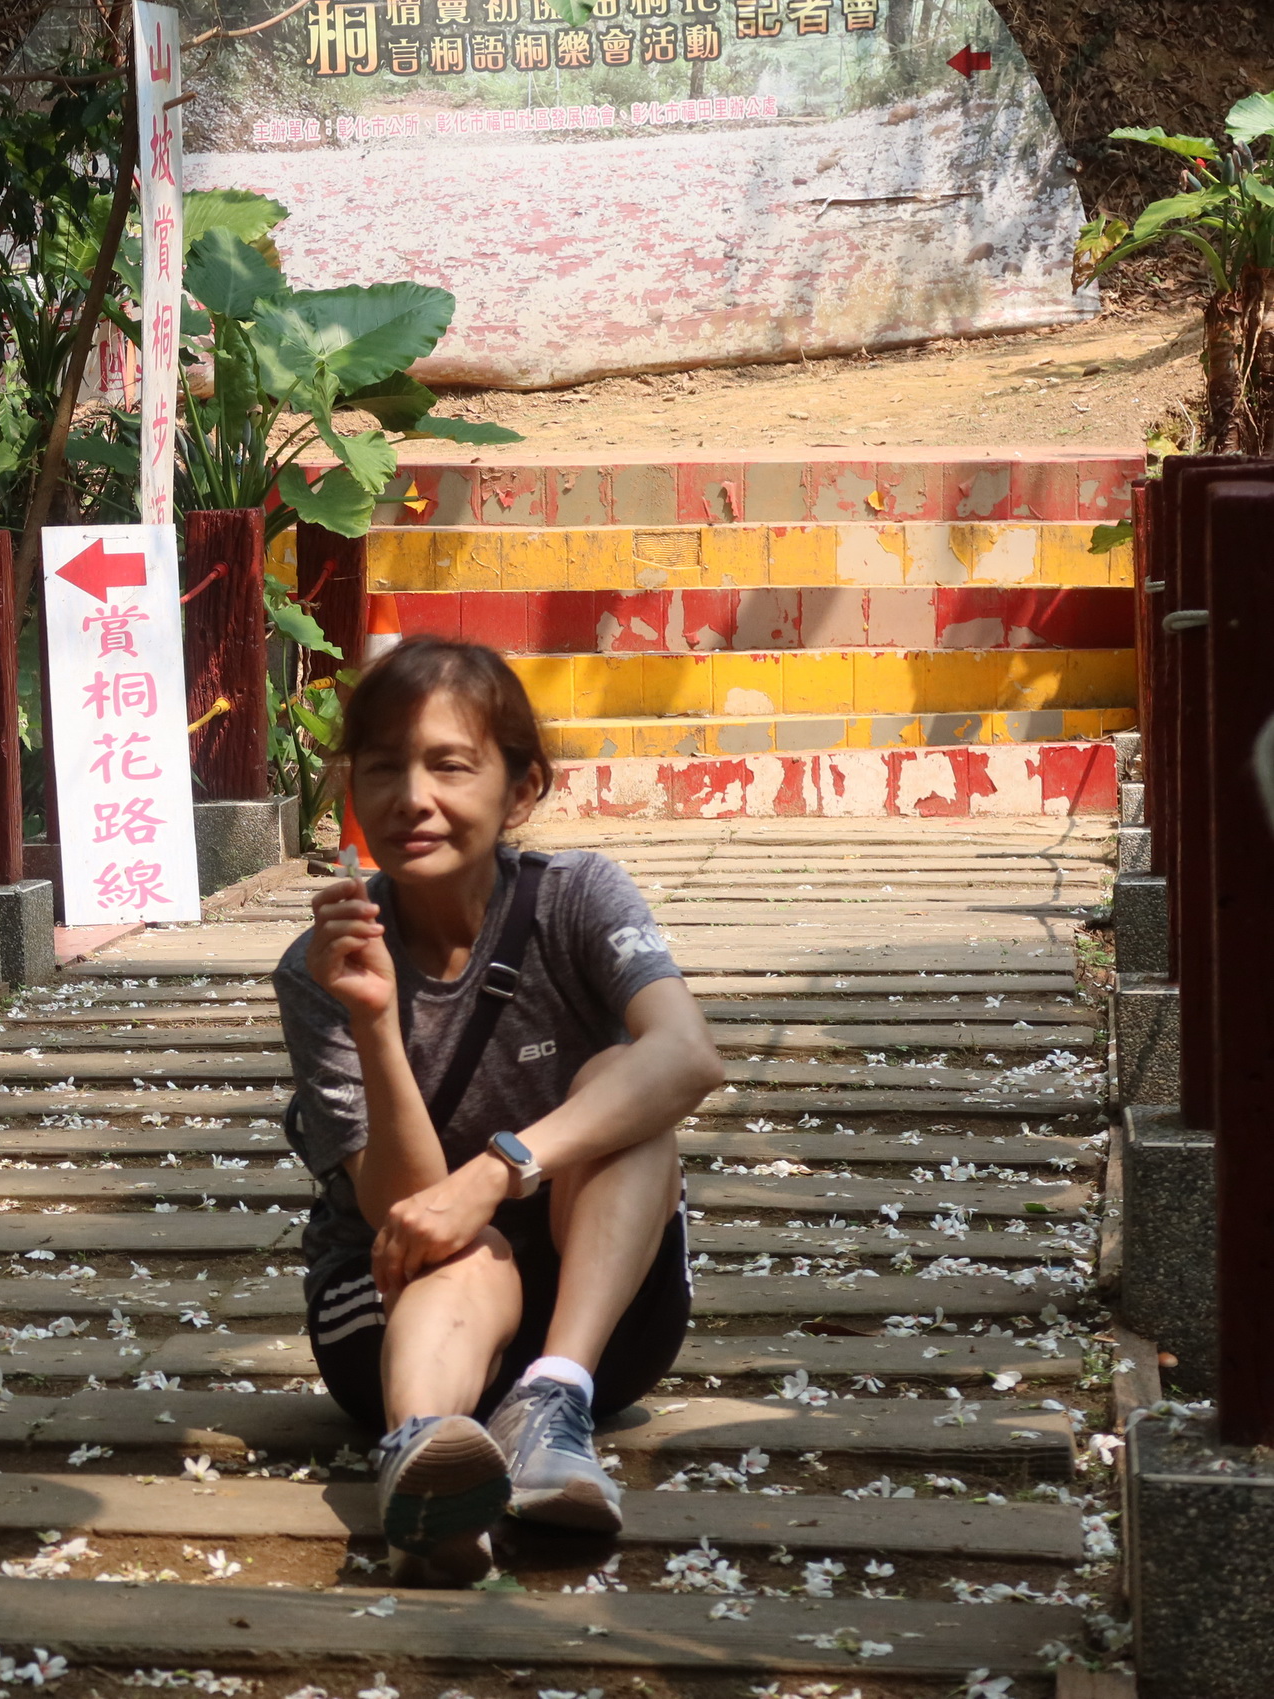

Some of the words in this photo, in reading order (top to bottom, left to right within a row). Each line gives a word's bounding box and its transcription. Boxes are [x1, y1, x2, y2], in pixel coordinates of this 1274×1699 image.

[306, 0, 378, 75] 桐
[737, 0, 876, 38] 記者會
[388, 23, 719, 74] 言桐語桐樂會活動
[82, 604, 173, 910] 賞桐花路線
[517, 1039, 557, 1063] BC
